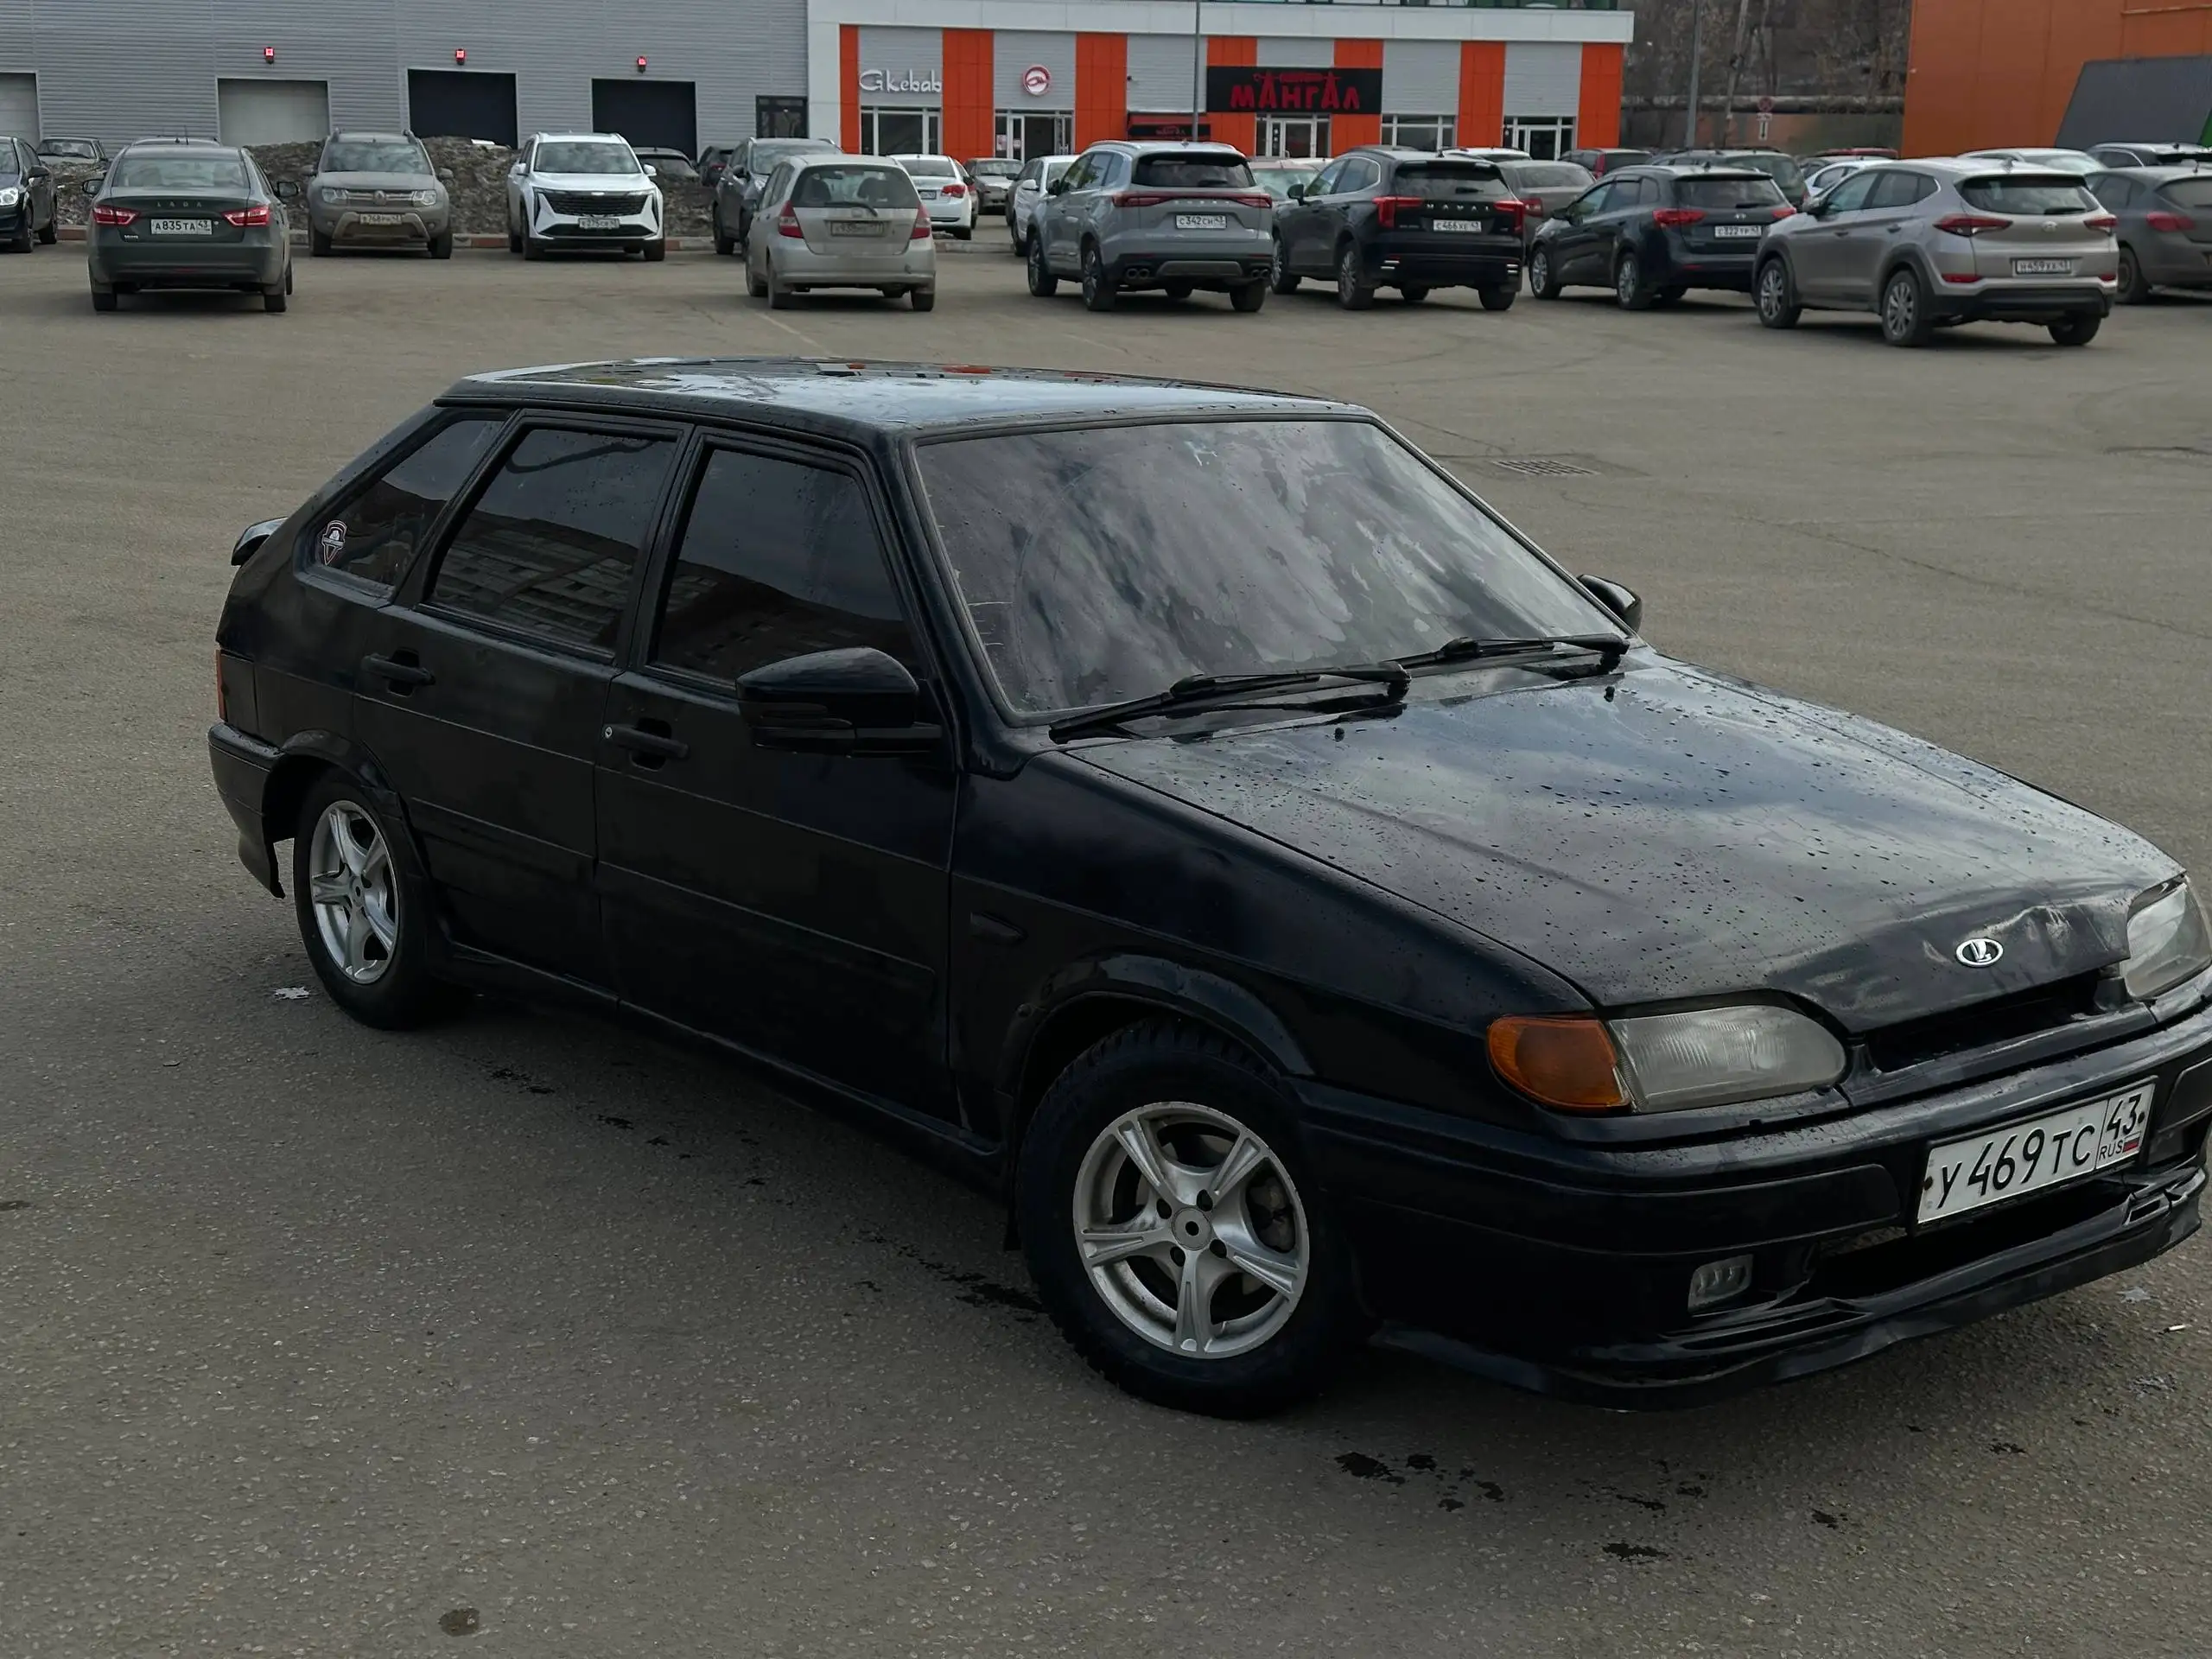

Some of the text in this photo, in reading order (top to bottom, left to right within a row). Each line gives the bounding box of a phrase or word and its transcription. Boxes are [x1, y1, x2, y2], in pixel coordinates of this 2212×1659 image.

[1230, 72, 1361, 110] МАНГАЛ
[155, 219, 208, 231] А835ТА 43
[1179, 215, 1213, 226] С342СН
[1937, 1093, 2142, 1210] У469ТС 43
[2098, 1139, 2124, 1161] RUS
